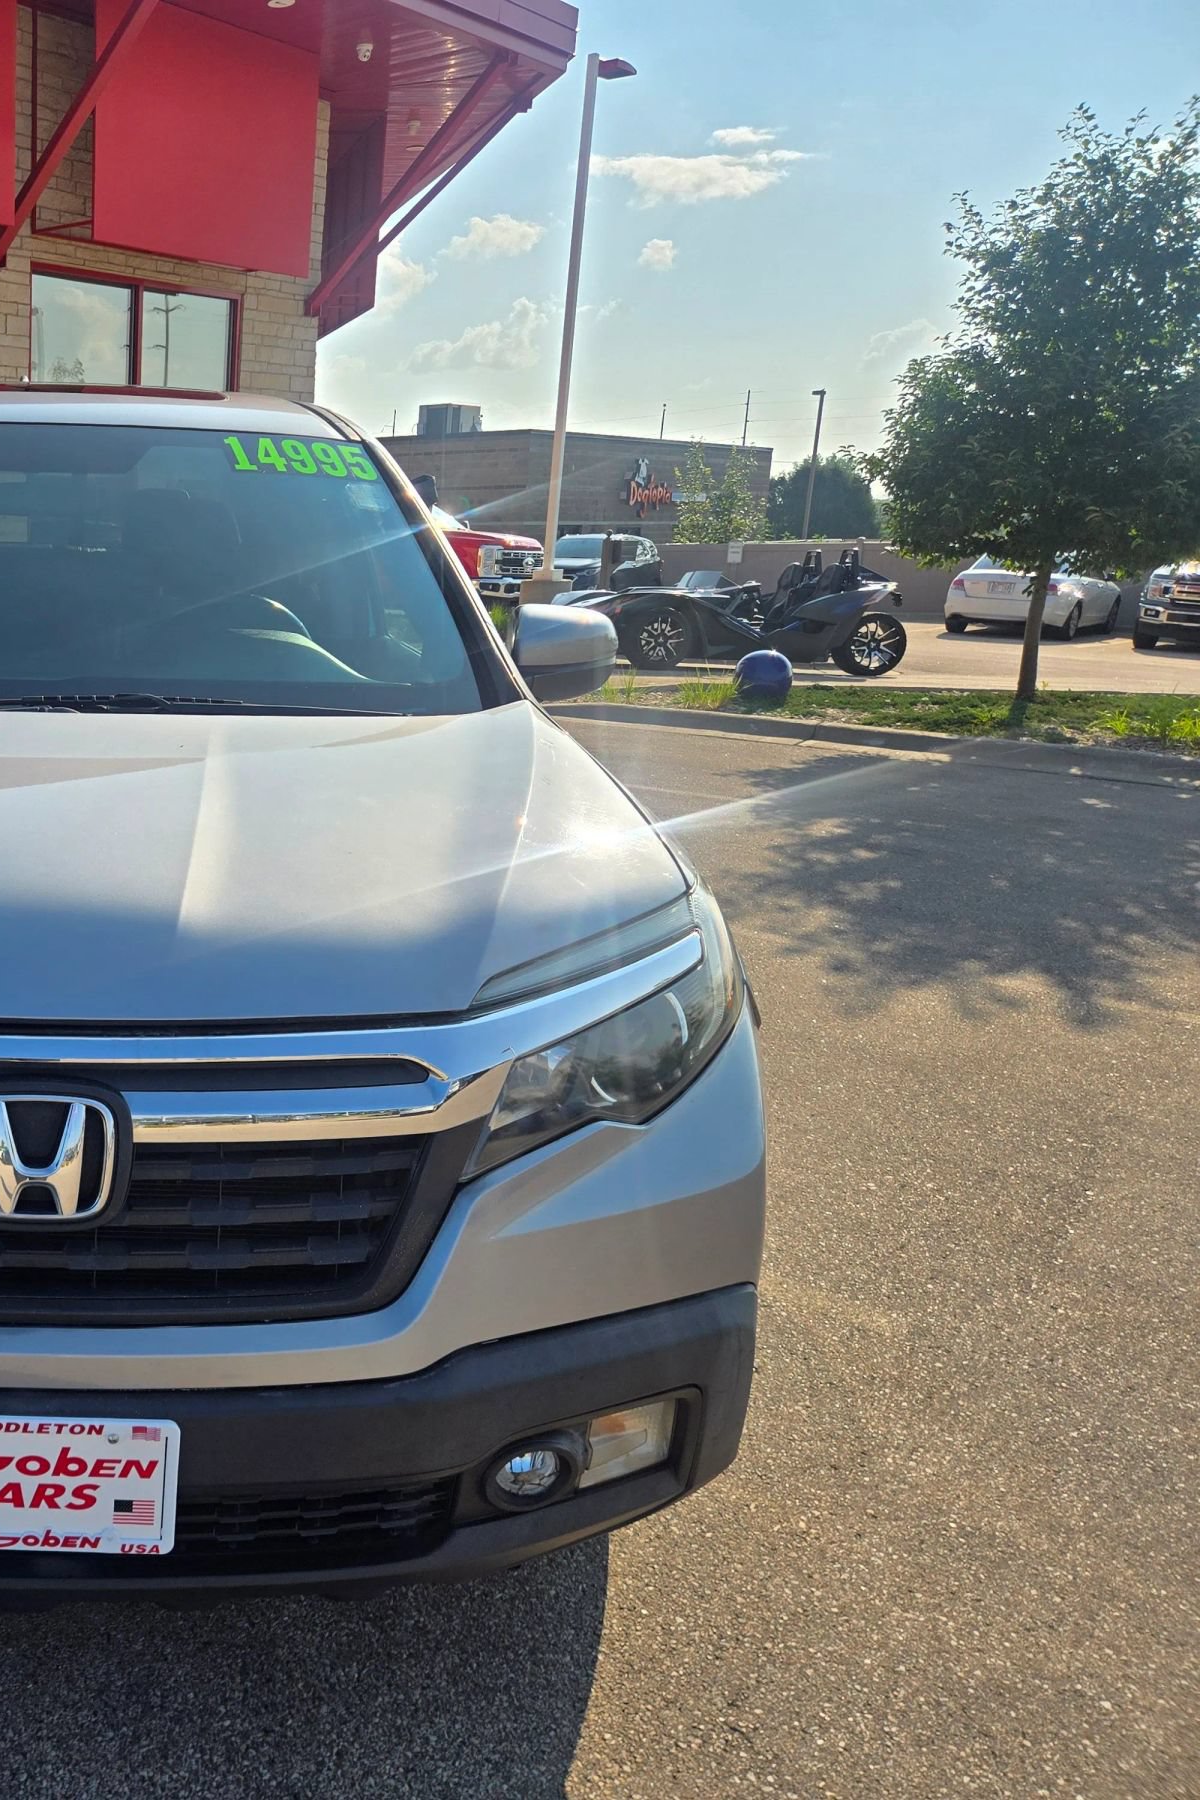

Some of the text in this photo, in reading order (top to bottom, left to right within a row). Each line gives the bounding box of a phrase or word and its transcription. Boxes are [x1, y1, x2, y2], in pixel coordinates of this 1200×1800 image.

[224, 436, 377, 480] 14995
[629, 473, 672, 518] Dogtopia
[120, 1543, 161, 1554] USA
